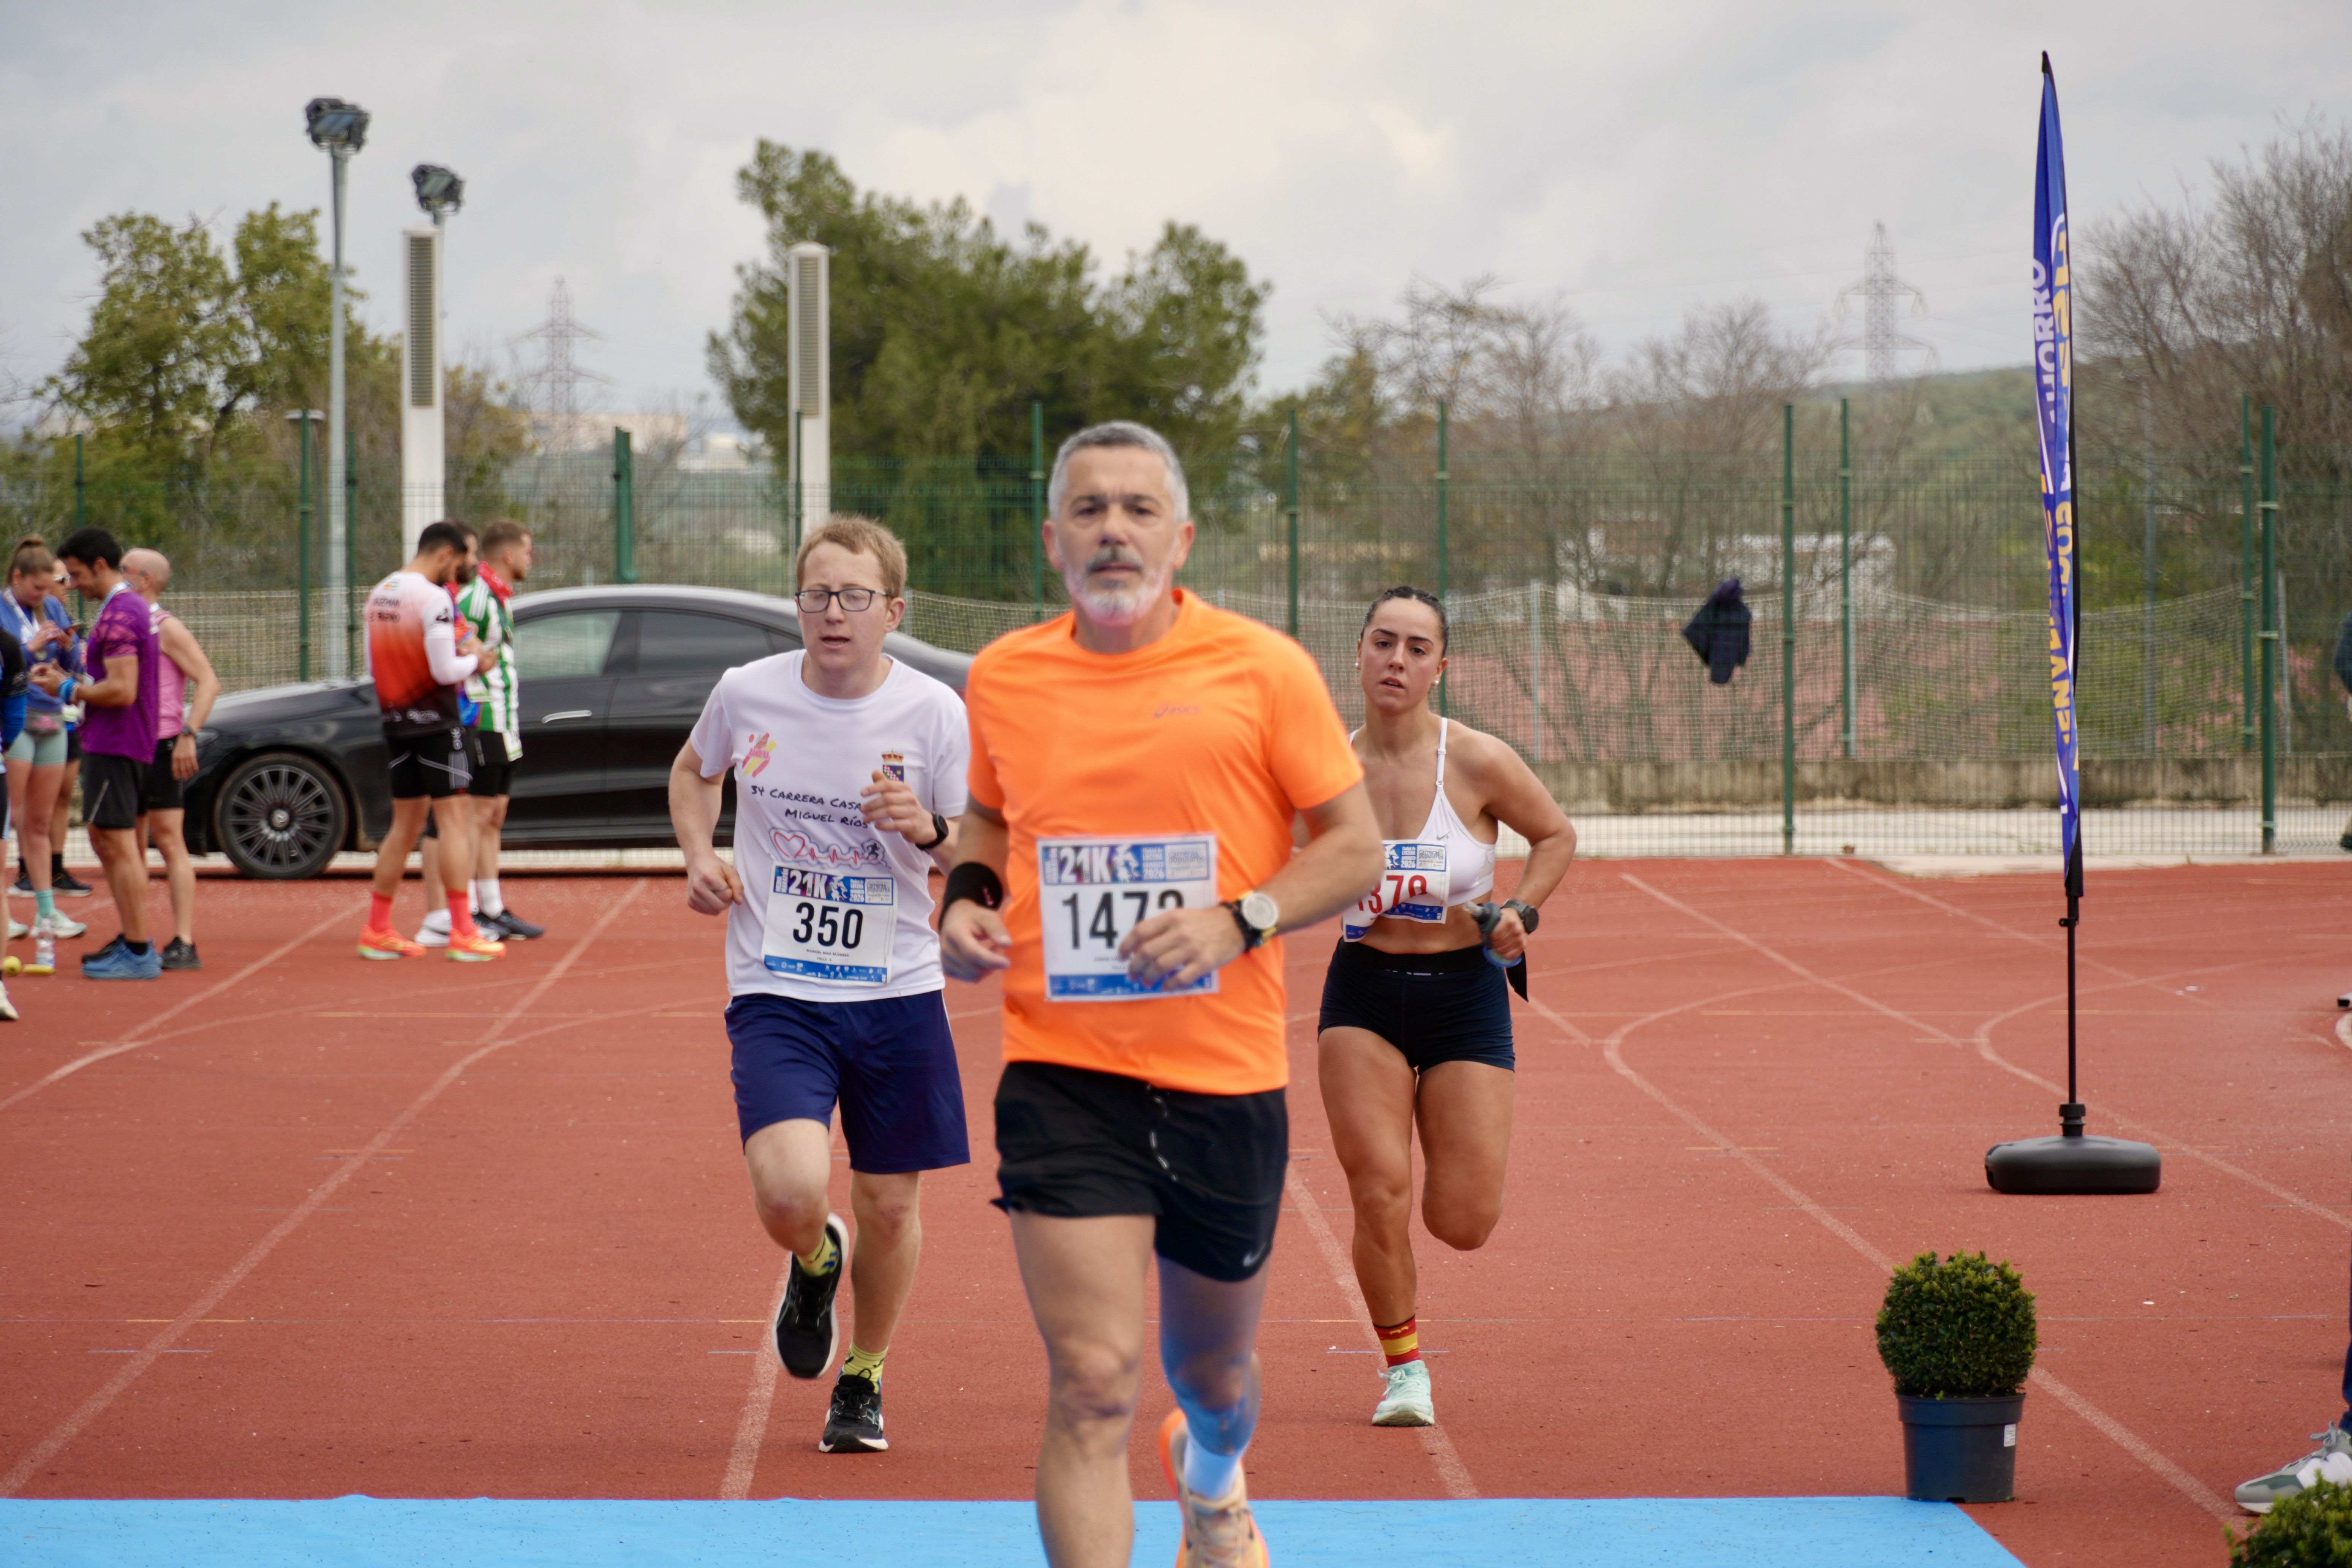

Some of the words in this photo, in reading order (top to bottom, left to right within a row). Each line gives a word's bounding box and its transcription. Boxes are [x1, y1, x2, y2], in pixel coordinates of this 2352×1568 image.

[770, 788, 824, 805] CARRERA
[785, 809, 835, 823] MIGUEL
[841, 816, 868, 829] RÍOS
[1060, 847, 1111, 883] 21K
[1169, 856, 1204, 865] populares
[1400, 860, 1416, 868] 2026
[1143, 868, 1165, 879] 2026
[789, 869, 828, 899] 21K
[849, 893, 864, 903] 2026
[793, 902, 863, 949] 350
